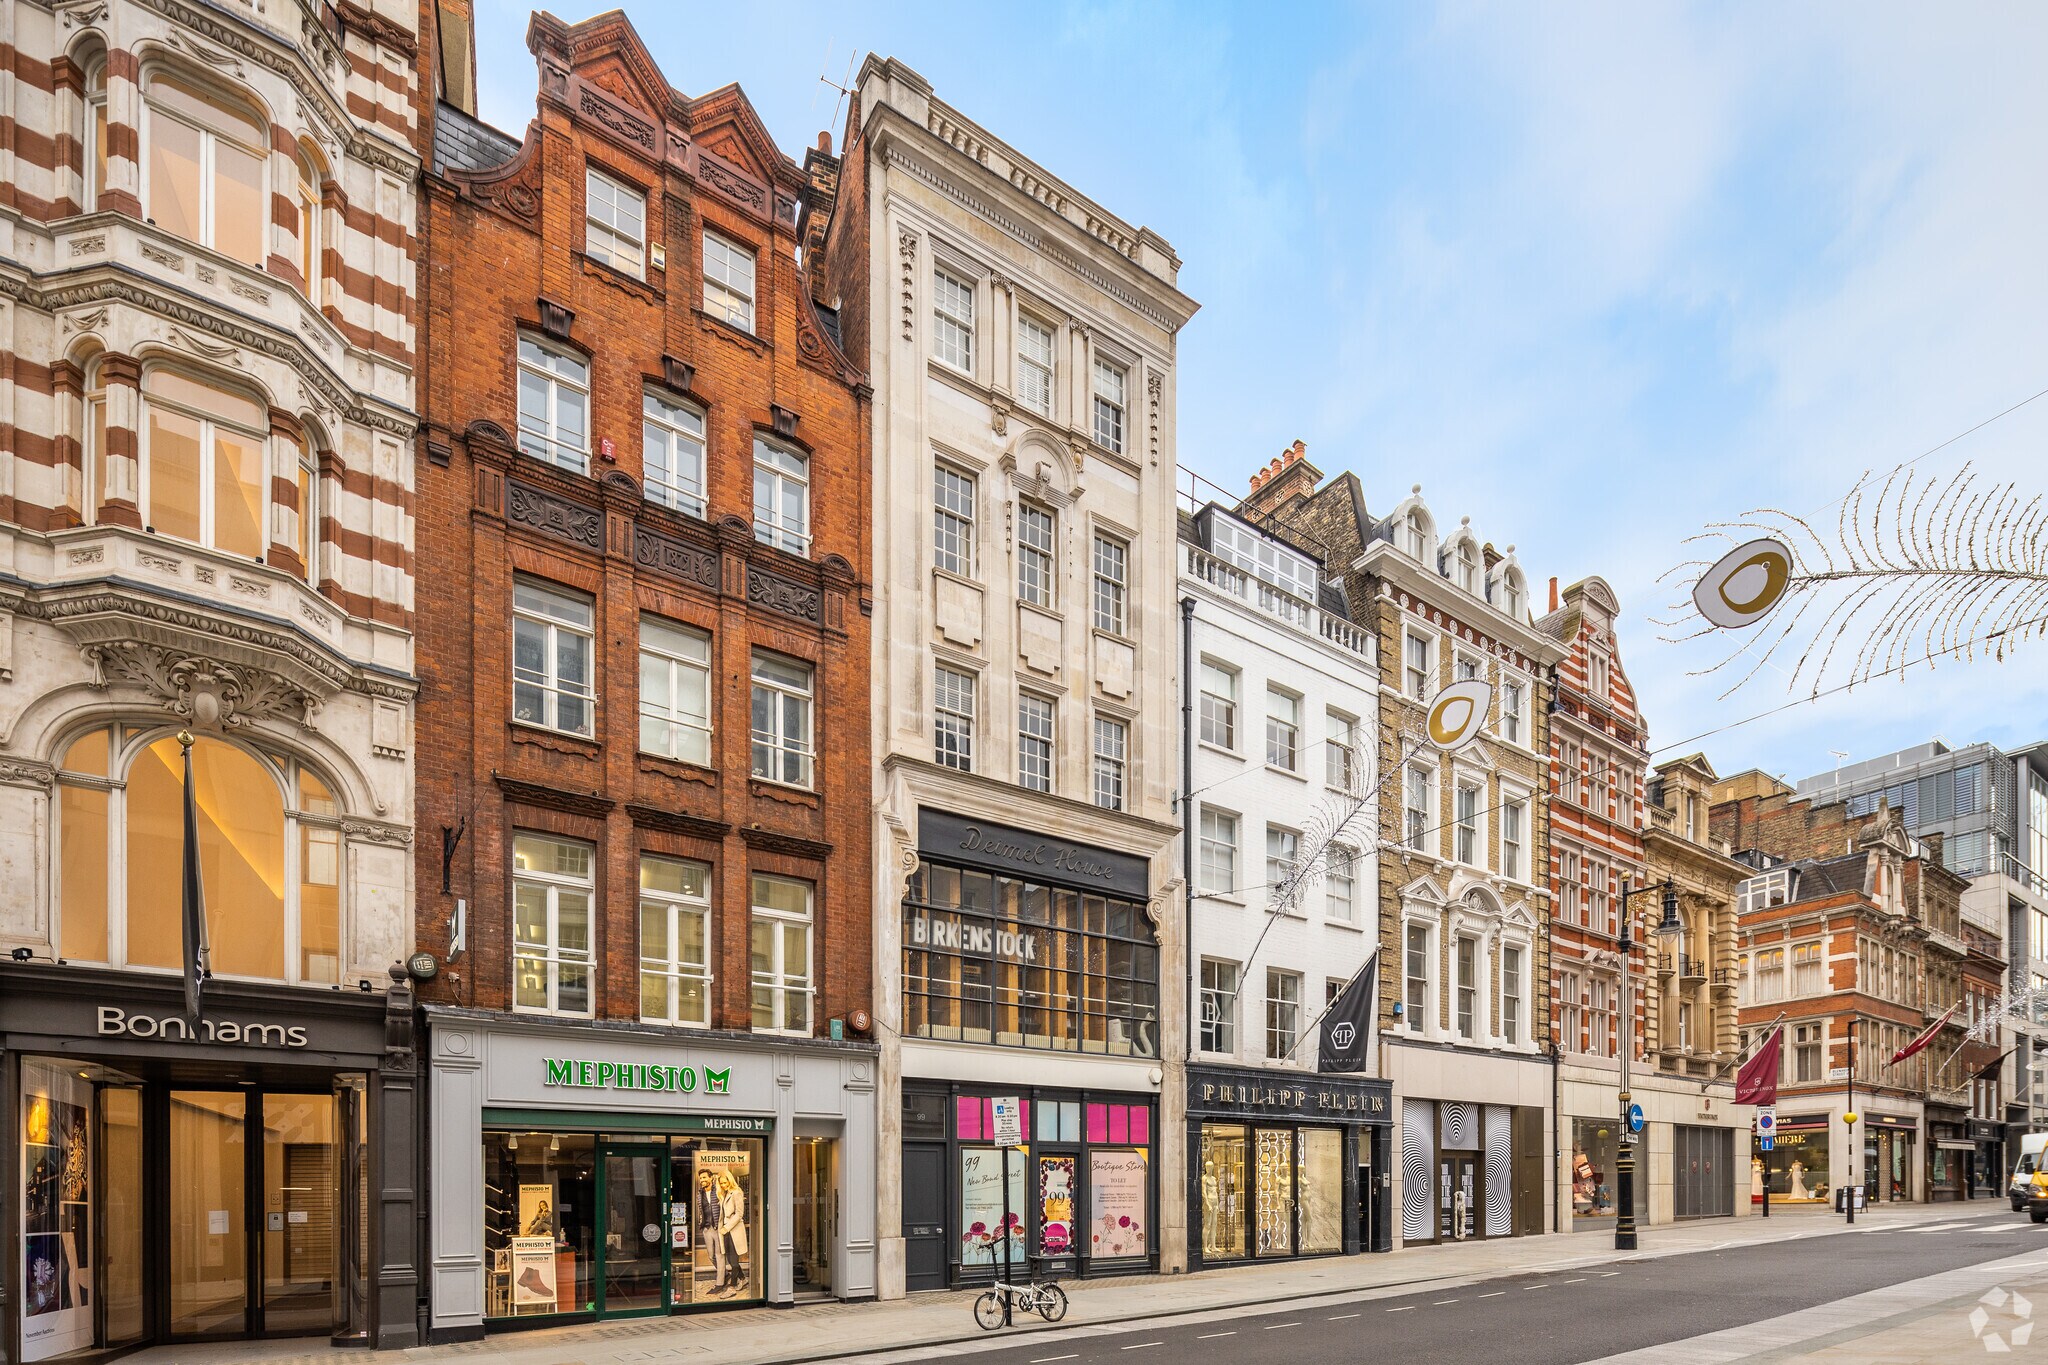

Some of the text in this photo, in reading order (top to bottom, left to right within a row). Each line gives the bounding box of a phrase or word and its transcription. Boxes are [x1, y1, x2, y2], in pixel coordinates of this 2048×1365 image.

[959, 826, 1115, 879] Deimel House
[914, 917, 1036, 960] BIRKENSTOCK
[543, 1058, 698, 1093] MEPHISTO
[1202, 1084, 1384, 1112] PHILIPP PLEIN
[704, 1118, 752, 1130] MEPHISTO
[965, 1156, 980, 1172] 99
[1092, 1160, 1144, 1174] Boutique Store
[1050, 1192, 1065, 1206] 99
